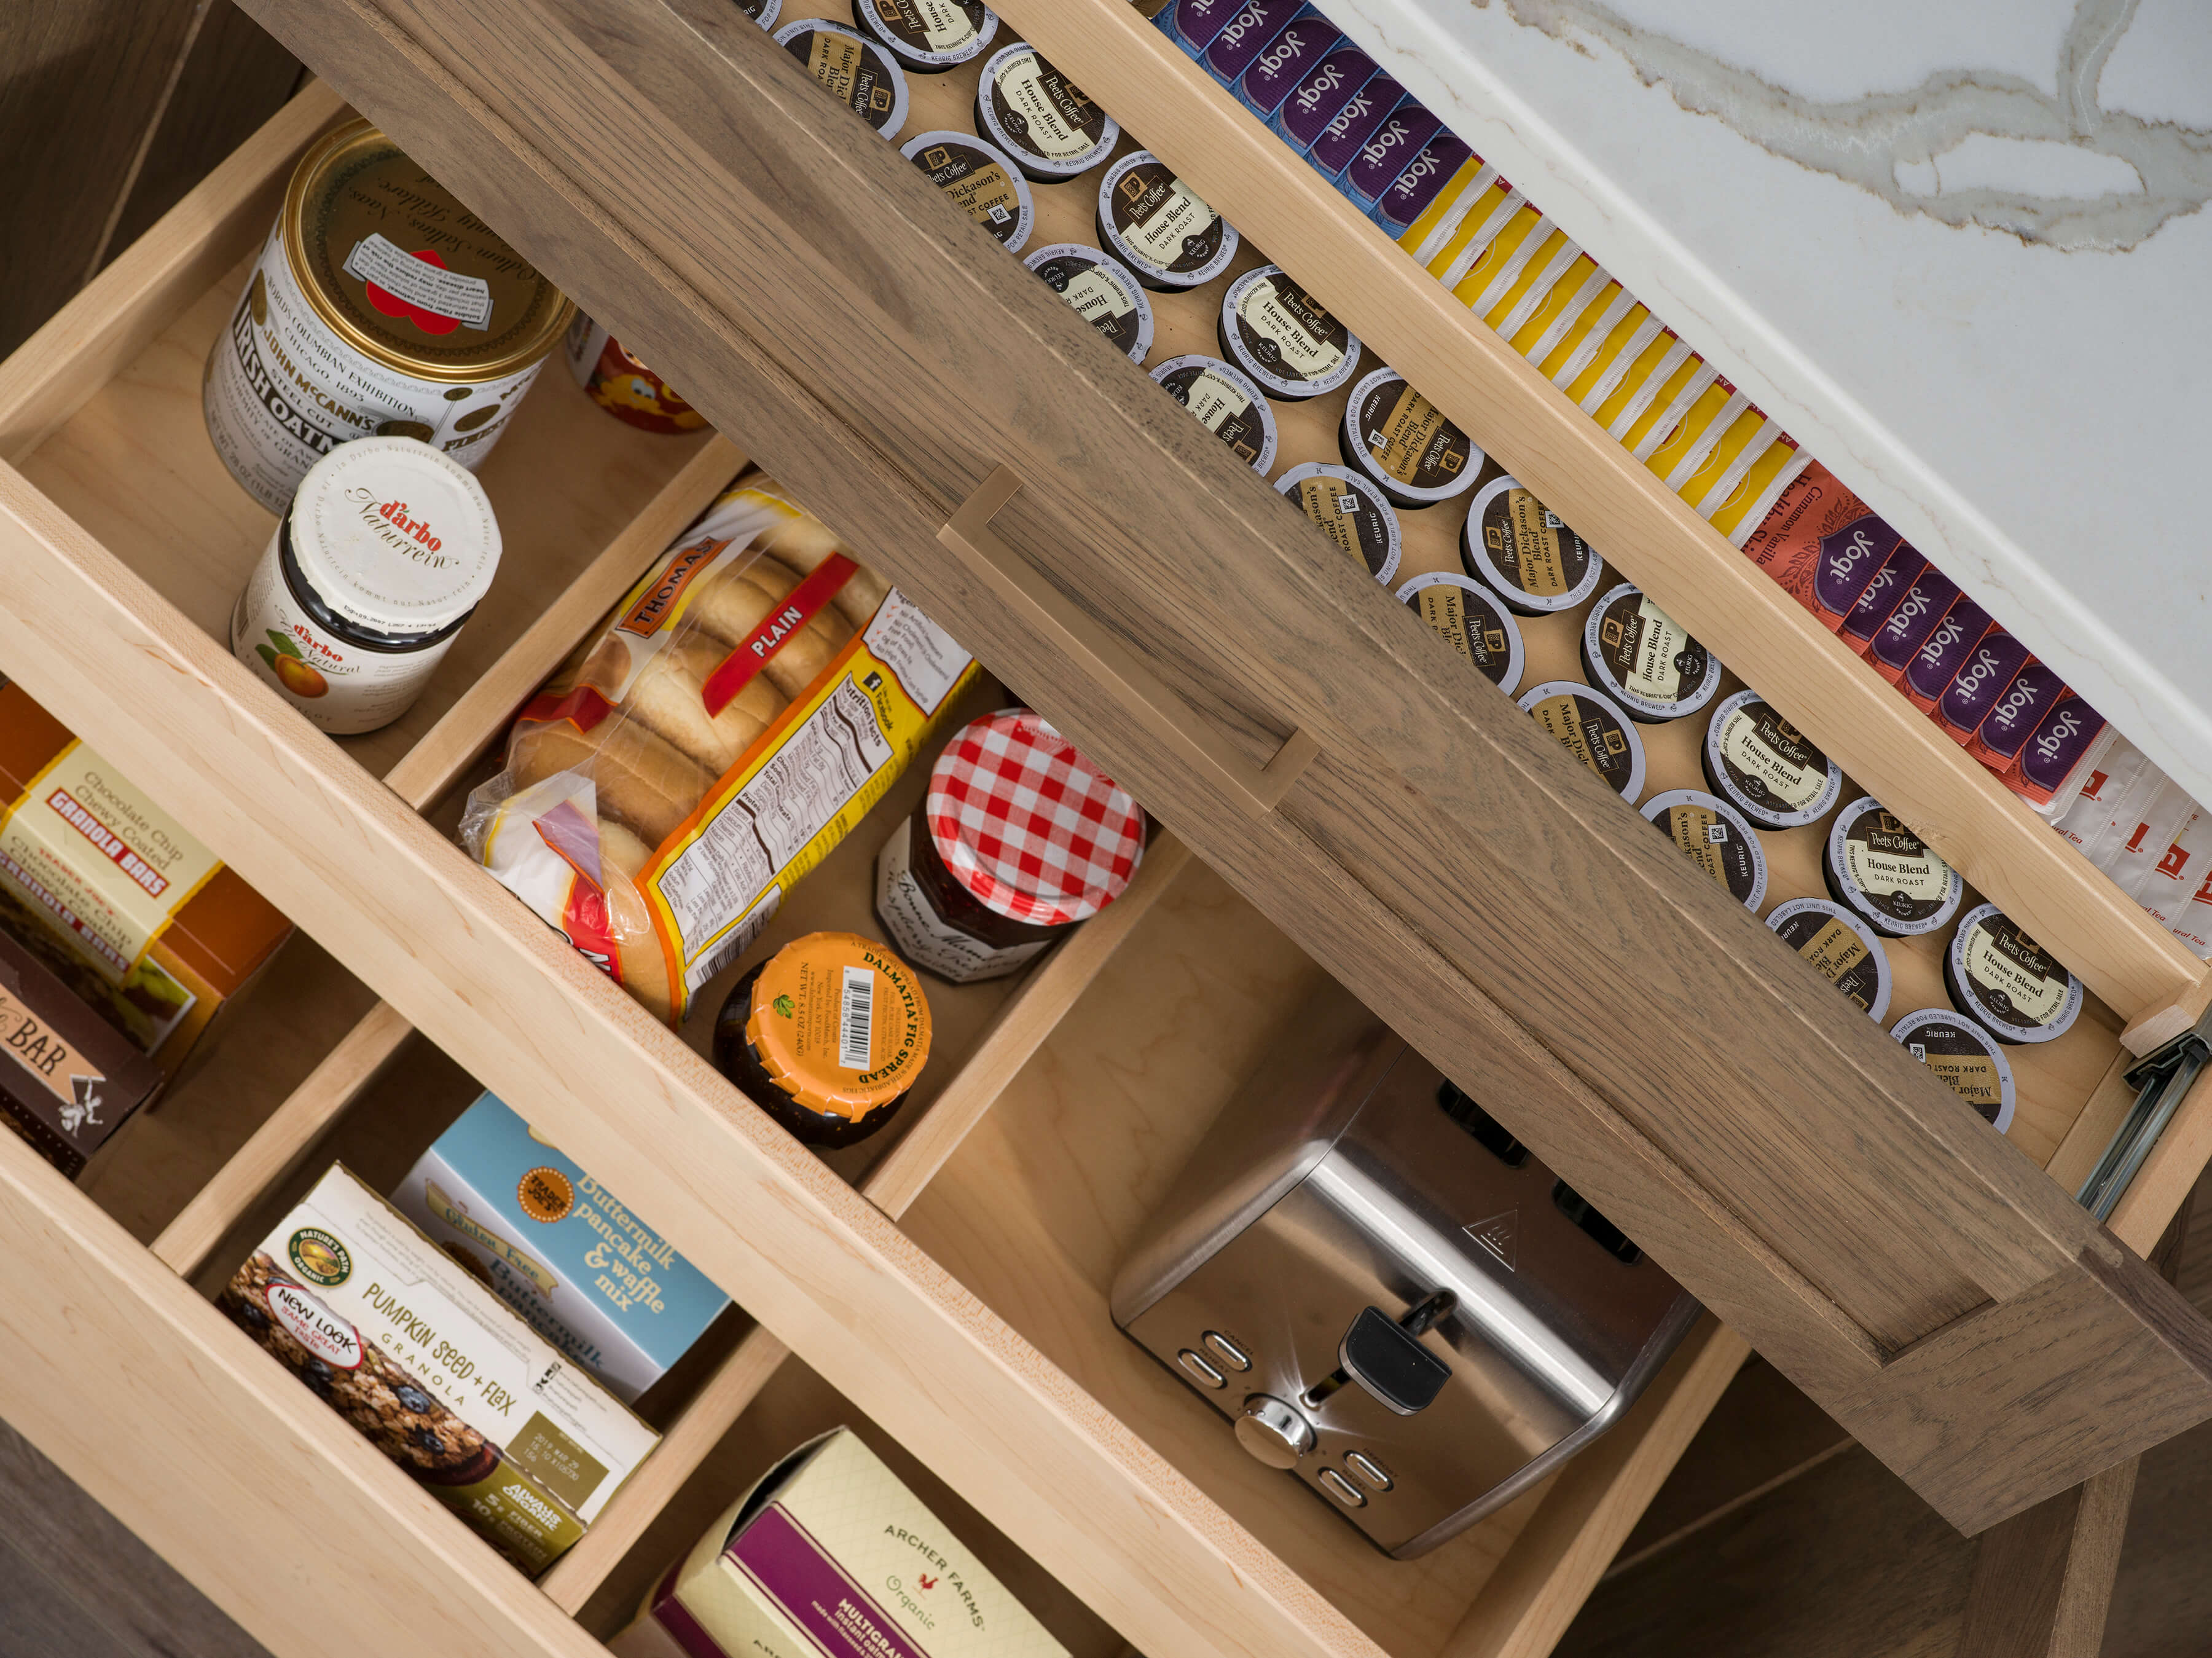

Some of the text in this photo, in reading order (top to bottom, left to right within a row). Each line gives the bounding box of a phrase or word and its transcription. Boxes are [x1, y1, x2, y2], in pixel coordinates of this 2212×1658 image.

[926, 1, 947, 32] House
[941, 2, 955, 23] DARK
[1015, 90, 1053, 140] DARK ROAST
[1021, 79, 1069, 141] House Blend
[1059, 98, 1083, 124] Coffee
[1062, 147, 1079, 157] RETAIL
[1079, 142, 1090, 151] SALE
[979, 193, 1009, 211] COFFEE
[1129, 183, 1166, 221] Peet's Coffee
[1144, 197, 1191, 245] House Blend
[1112, 234, 1129, 254] KEURIG
[1159, 213, 1196, 249] DARK ROAST
[1076, 294, 1108, 314] House
[1283, 293, 1325, 336] Peet's Coffee
[233, 299, 272, 398] IRISH
[1261, 315, 1281, 336] DARK
[1281, 335, 1305, 359] ROAST
[1263, 301, 1319, 358] House Blend
[263, 329, 297, 379] JOHN
[290, 316, 418, 417] COLUMBIAN EXHIBITION
[270, 367, 335, 429] STEEL CUT
[335, 381, 365, 402] 1893
[1365, 395, 1381, 419] KEURIG
[1201, 398, 1225, 425] House
[1381, 392, 1421, 461] DARK ROAST COFFEE
[1396, 431, 1426, 476] Dickason's
[1398, 420, 1419, 449] Blend
[344, 487, 460, 570] Naturrein
[1329, 486, 1351, 551] ROAST COFFEE
[1370, 513, 1383, 544] KEURIG
[1756, 487, 1822, 565] Cinnamon Vanilla
[1519, 496, 1539, 588] Major Dickason's
[1531, 530, 1543, 560] Blend
[1543, 536, 1558, 586] DARK ROAST
[353, 580, 471, 607] kommt nur Natur rein
[1445, 595, 1458, 630] Major
[750, 605, 803, 659] PLAIN
[1618, 616, 1638, 666] Peet's Coffee
[1643, 619, 1663, 682] House Blend
[304, 648, 361, 675] Natural
[1657, 631, 1672, 681] DARK ROAST
[845, 677, 871, 720] Nutrition
[1559, 703, 1577, 739] Major
[1741, 735, 1802, 785] House Blend
[1761, 721, 1805, 761] Peet's Coffee
[1741, 751, 1789, 789] DARK ROAST
[74, 784, 171, 873] Chewy Coated
[84, 770, 184, 863] Chocolate Chip
[1700, 814, 1711, 851] COFFEE
[49, 792, 167, 896] GRANOLA BARS
[1870, 832, 1917, 851] Peet's Coffee
[2069, 831, 2083, 844] Tea
[1736, 844, 1748, 878] KEURIG
[1867, 858, 1930, 874] House Blend
[1874, 874, 1894, 884] DARK
[1884, 917, 1904, 929] KEURIG
[2191, 933, 2206, 946] Tea
[1999, 933, 2043, 972] Peet's Coffee
[1983, 950, 2044, 998] House Blend
[1983, 966, 2033, 1002] DARK ROAST
[796, 1016, 804, 1029] OZ
[816, 1014, 822, 1024] NY
[904, 1022, 916, 1047] FIG
[1916, 1015, 1928, 1024] FOR
[7, 1016, 67, 1076] BAR
[796, 1031, 804, 1056] (240G)
[859, 1048, 907, 1083] SPREAD
[1959, 1086, 1992, 1098] Major
[530, 1174, 567, 1213] TRADER
[574, 1201, 651, 1276] pancake
[577, 1174, 675, 1271] Buttermilk
[292, 1257, 326, 1285] ORGANIC
[337, 1248, 350, 1273] PATH
[506, 1248, 540, 1281] Free
[584, 1244, 665, 1315] & waffle
[595, 1278, 634, 1314] mix
[313, 1313, 356, 1355] LOOK
[380, 1331, 466, 1408] GRANOLA
[533, 1433, 554, 1452] 2019
[554, 1448, 567, 1460] MAR
[566, 1458, 580, 1469] 29
[506, 1482, 562, 1526] ALWAYS
[884, 1523, 985, 1631] ARCHER FARMS
[885, 1574, 936, 1632] Organic
[834, 1608, 866, 1642] instant
